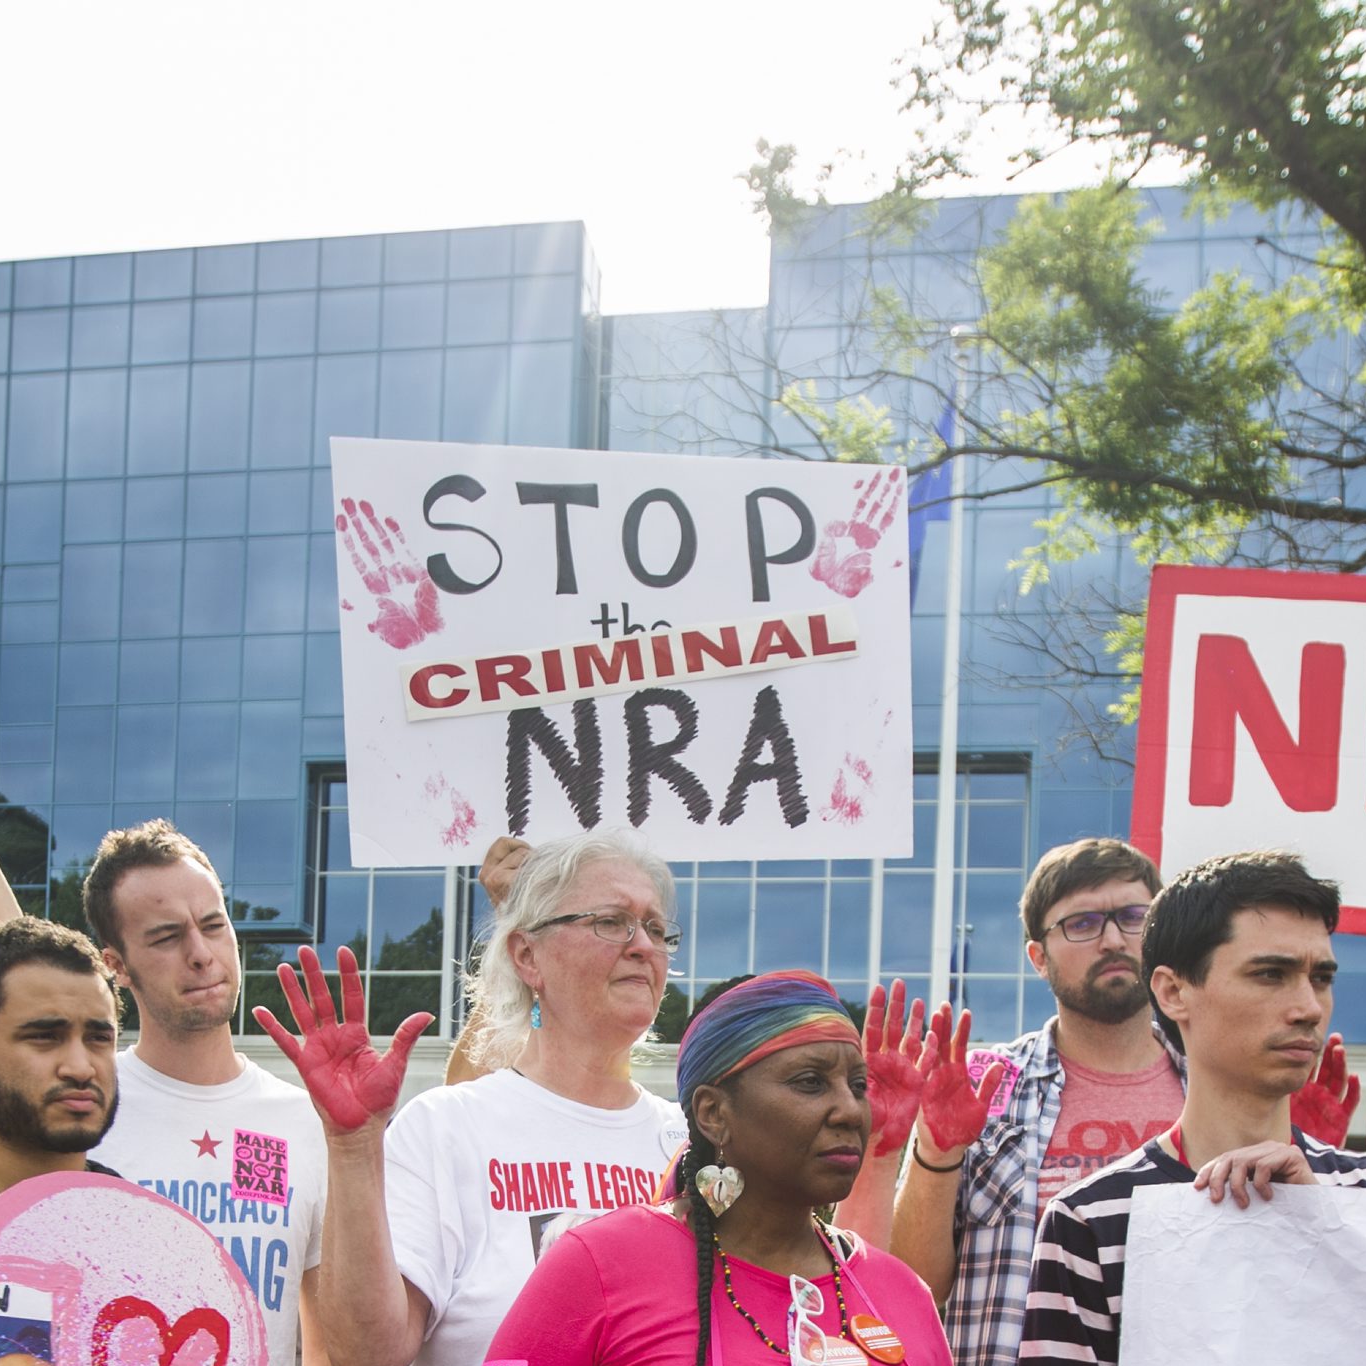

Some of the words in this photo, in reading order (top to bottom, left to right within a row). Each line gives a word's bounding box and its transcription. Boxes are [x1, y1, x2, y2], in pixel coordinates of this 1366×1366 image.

[423, 474, 816, 602] STOP
[409, 614, 857, 709] CRIMINAL
[504, 685, 810, 838] NRA
[236, 1132, 286, 1153] MAKE
[236, 1146, 286, 1166] OUT
[234, 1174, 284, 1196] WAR
[235, 1159, 286, 1181] NOT
[488, 1158, 578, 1212] SHAME
